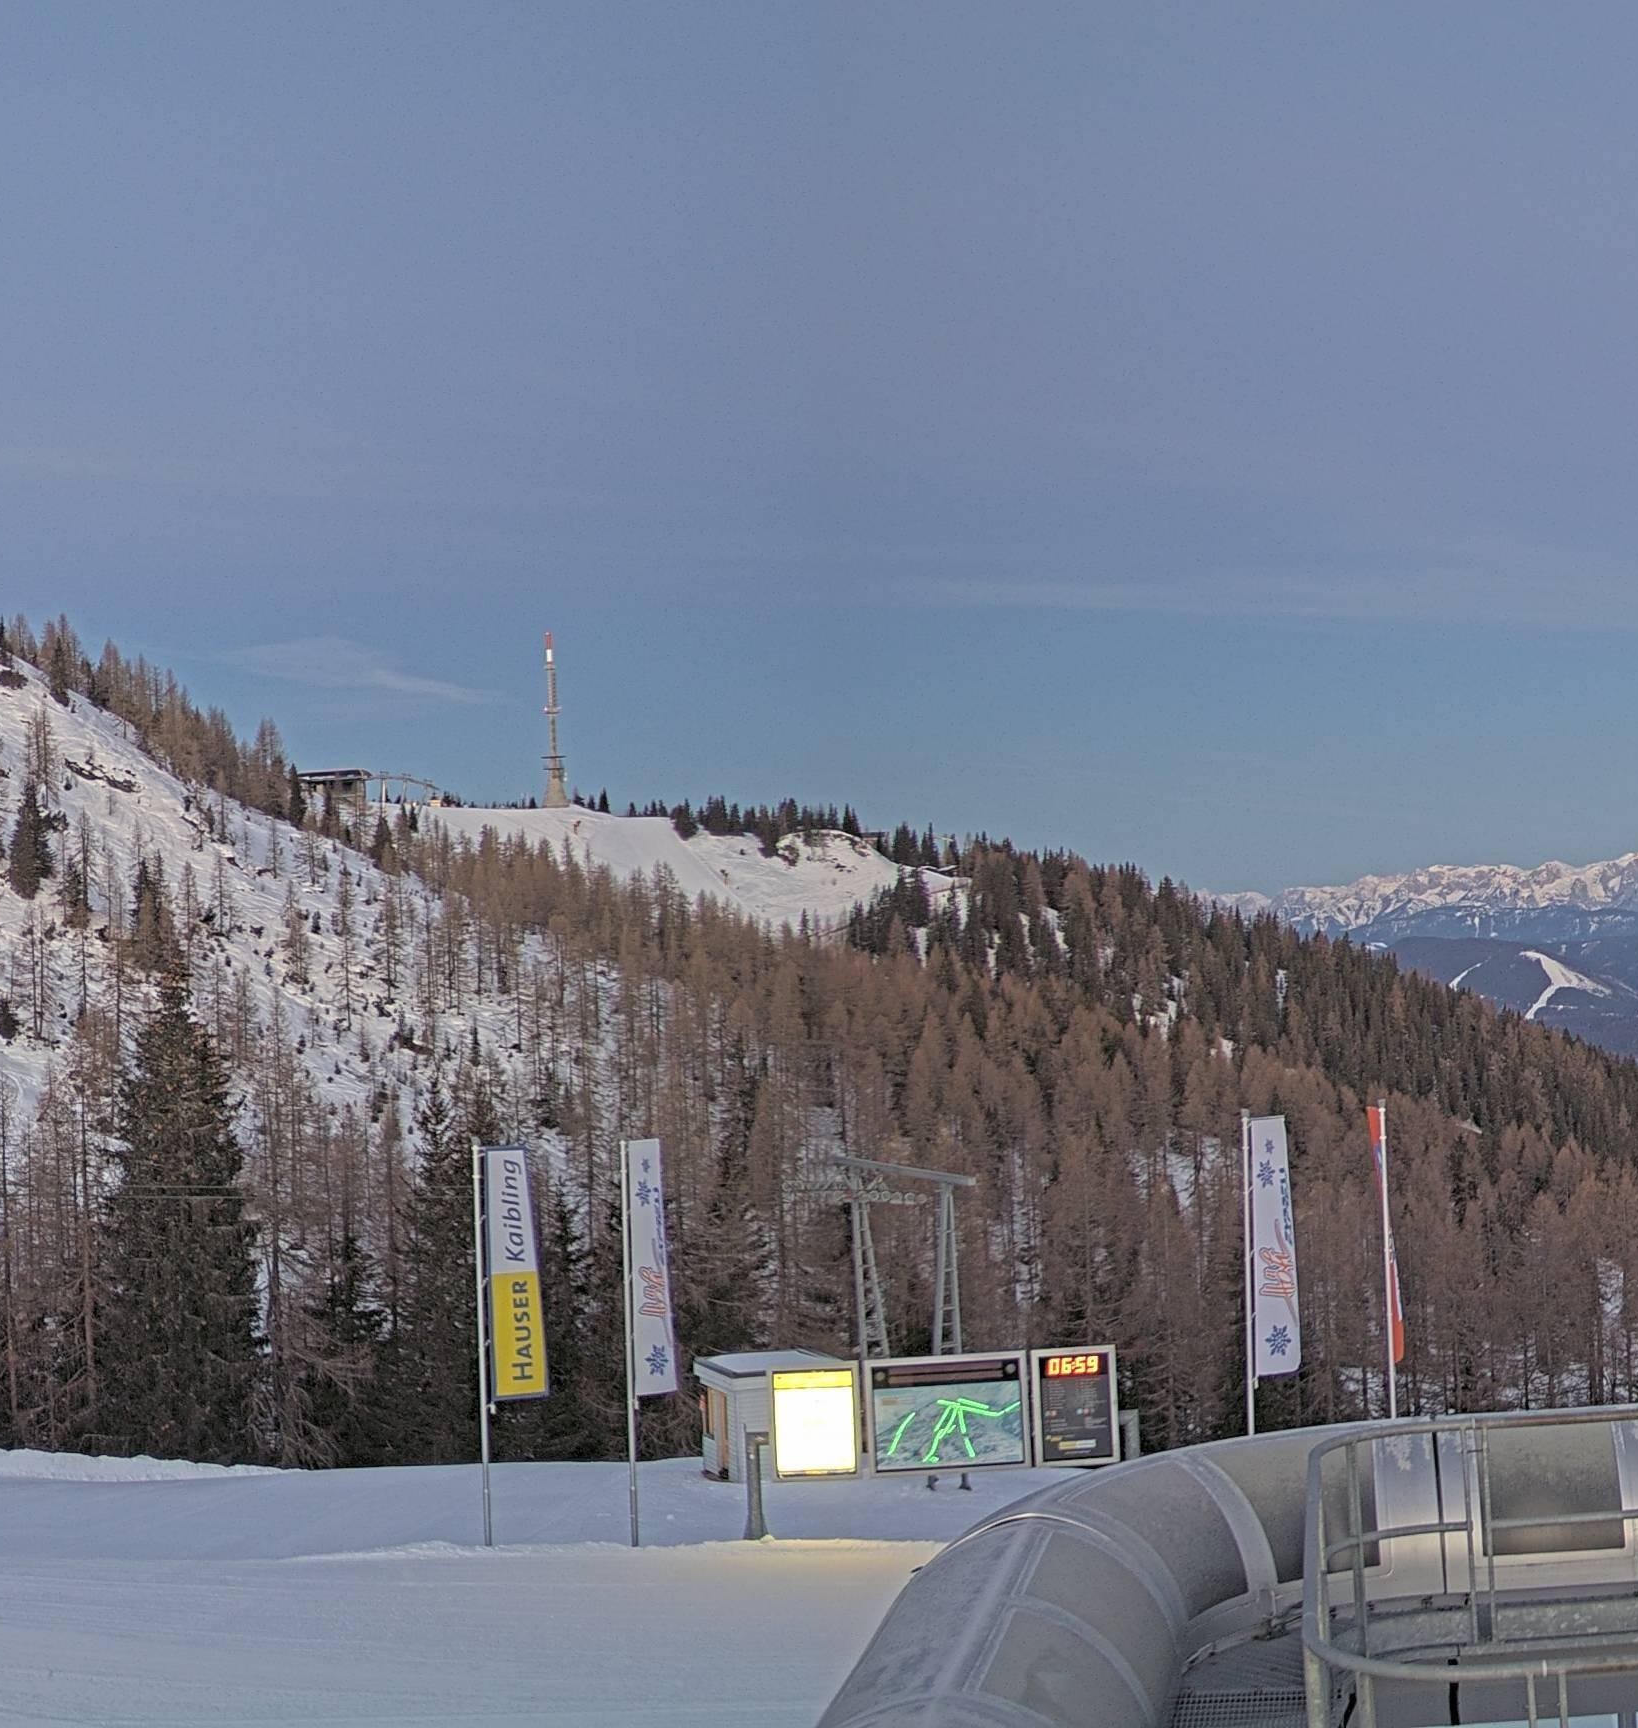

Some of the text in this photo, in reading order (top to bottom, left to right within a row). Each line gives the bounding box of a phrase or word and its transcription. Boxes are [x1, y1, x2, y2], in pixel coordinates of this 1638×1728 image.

[501, 1159, 534, 1381] HAUSER Kaibling
[1047, 1355, 1099, 1377] 06:59
